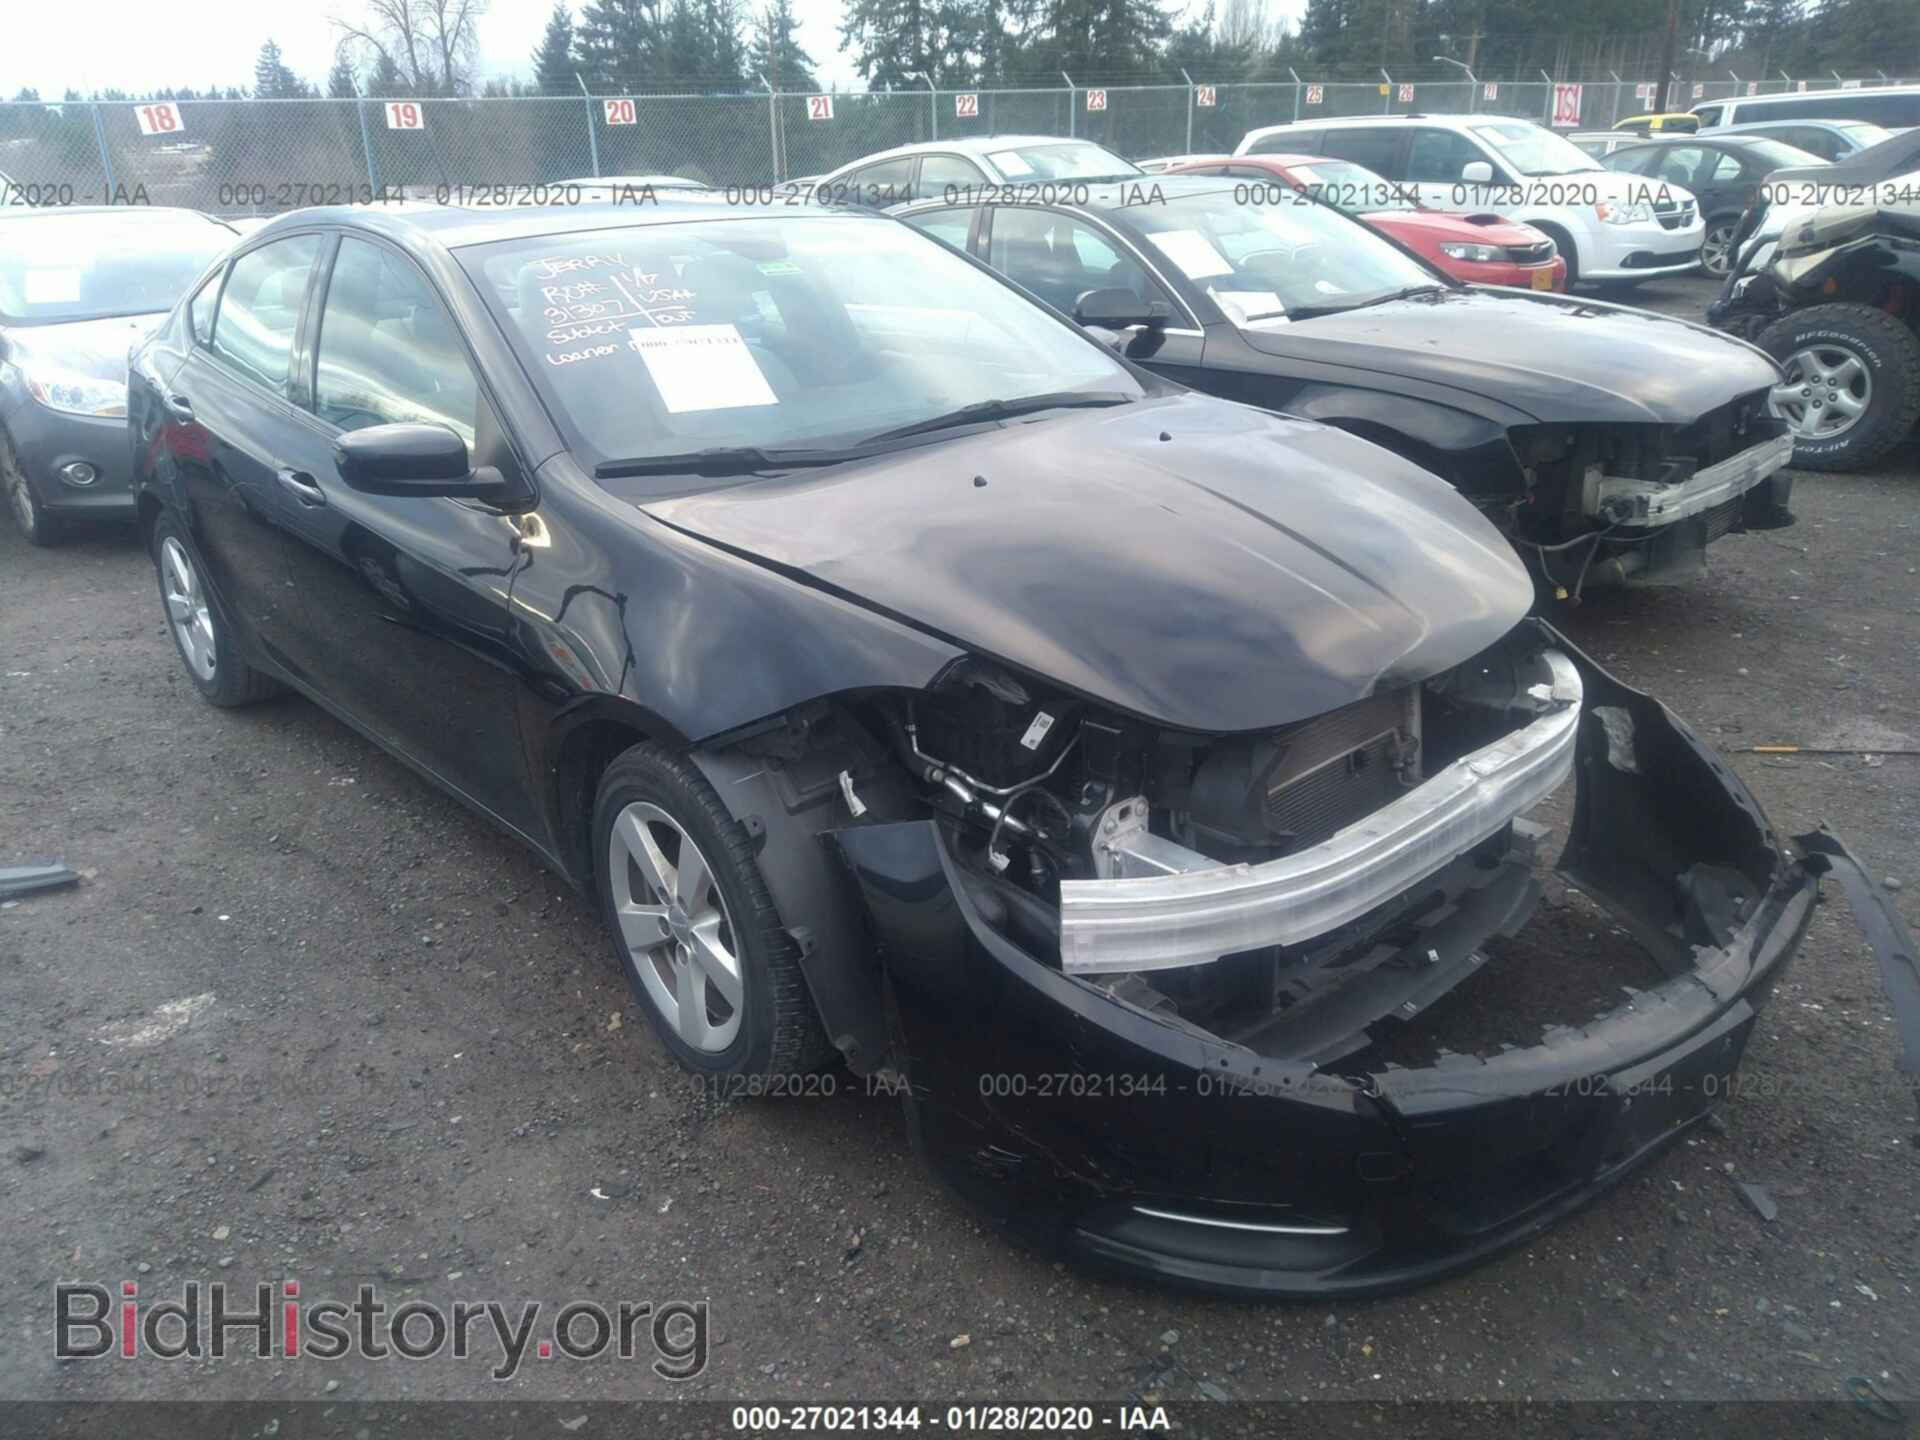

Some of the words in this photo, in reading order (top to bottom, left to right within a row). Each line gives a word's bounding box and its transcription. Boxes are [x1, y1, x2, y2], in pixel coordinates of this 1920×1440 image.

[957, 95, 977, 115] 22
[1088, 90, 1105, 109] 23
[1199, 87, 1216, 105] 24
[391, 103, 418, 128] 19
[607, 100, 634, 124] 20
[811, 97, 830, 118] 21
[143, 104, 177, 133] 18
